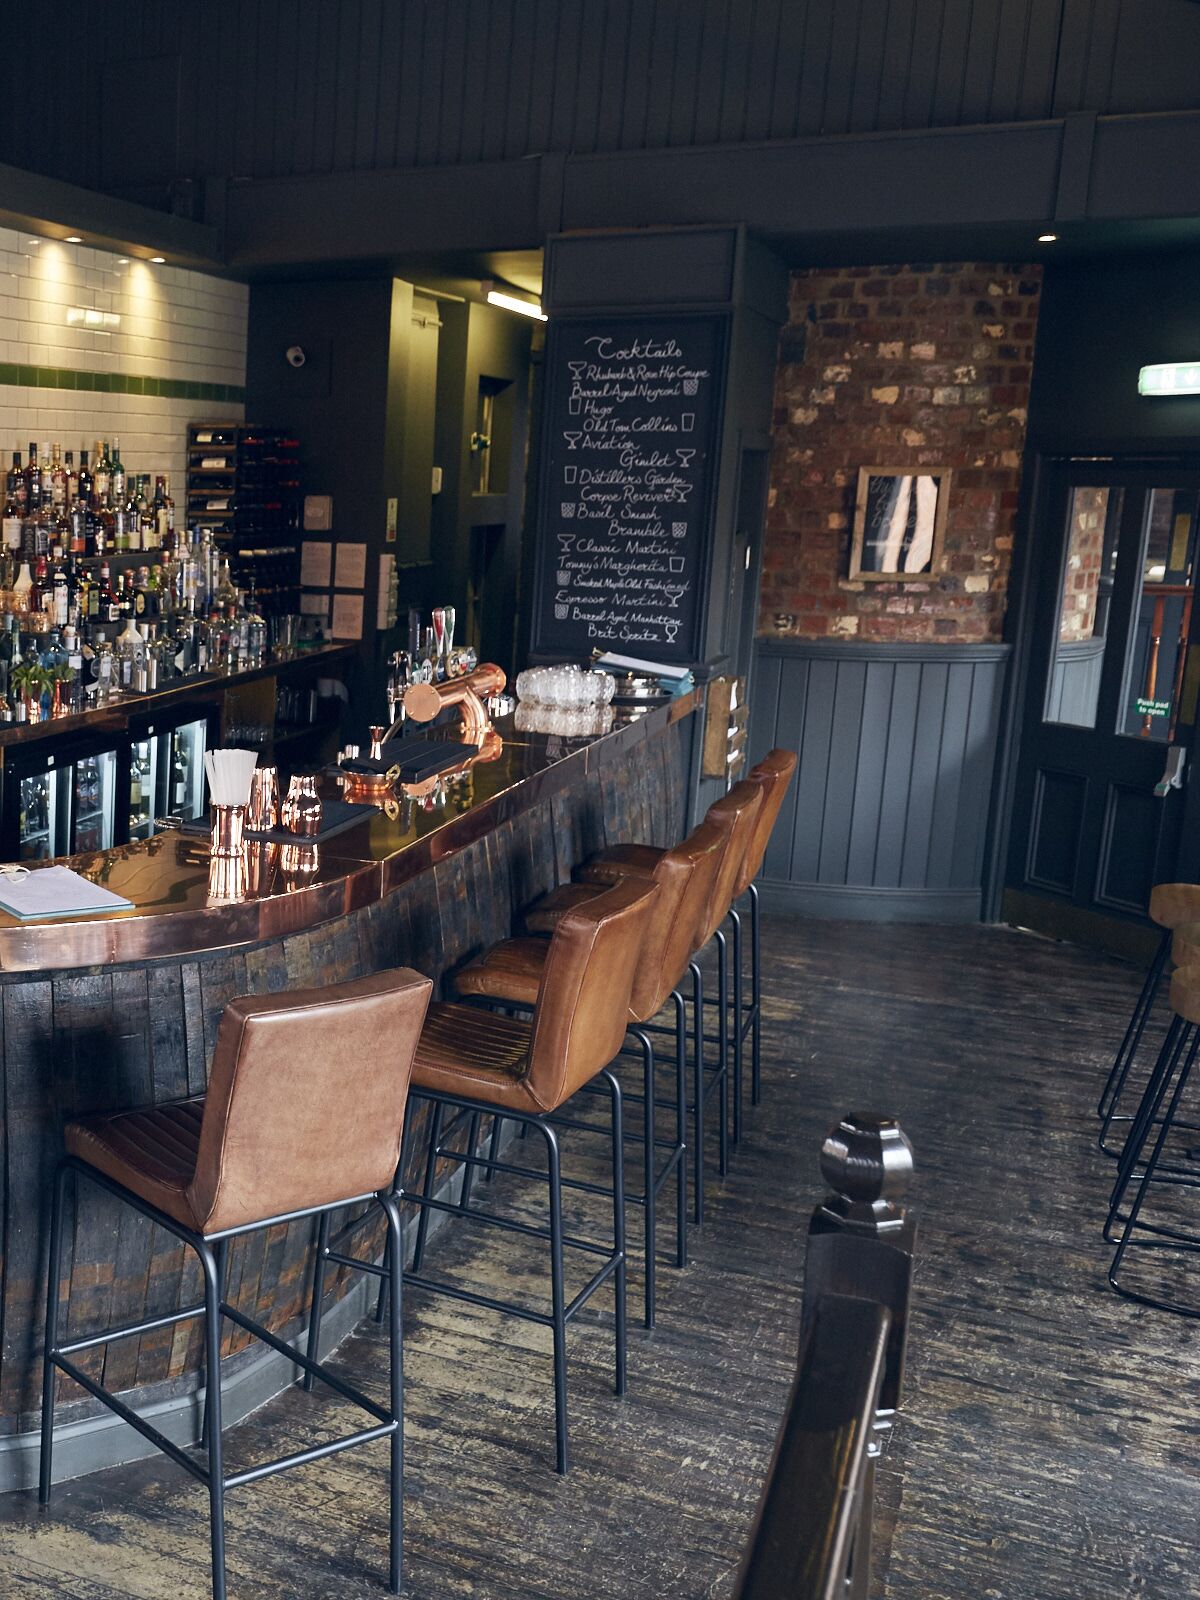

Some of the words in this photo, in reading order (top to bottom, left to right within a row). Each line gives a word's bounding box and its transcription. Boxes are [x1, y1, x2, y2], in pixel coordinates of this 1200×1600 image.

[584, 336, 682, 360] Cocktails
[584, 400, 614, 420] Hugo
[583, 418, 608, 432] Old
[632, 417, 678, 432] Collins
[582, 435, 640, 449] Aviation
[577, 502, 615, 519] Basil
[608, 520, 669, 537] Bramble
[625, 540, 678, 554] Martini
[612, 593, 667, 606] Martini
